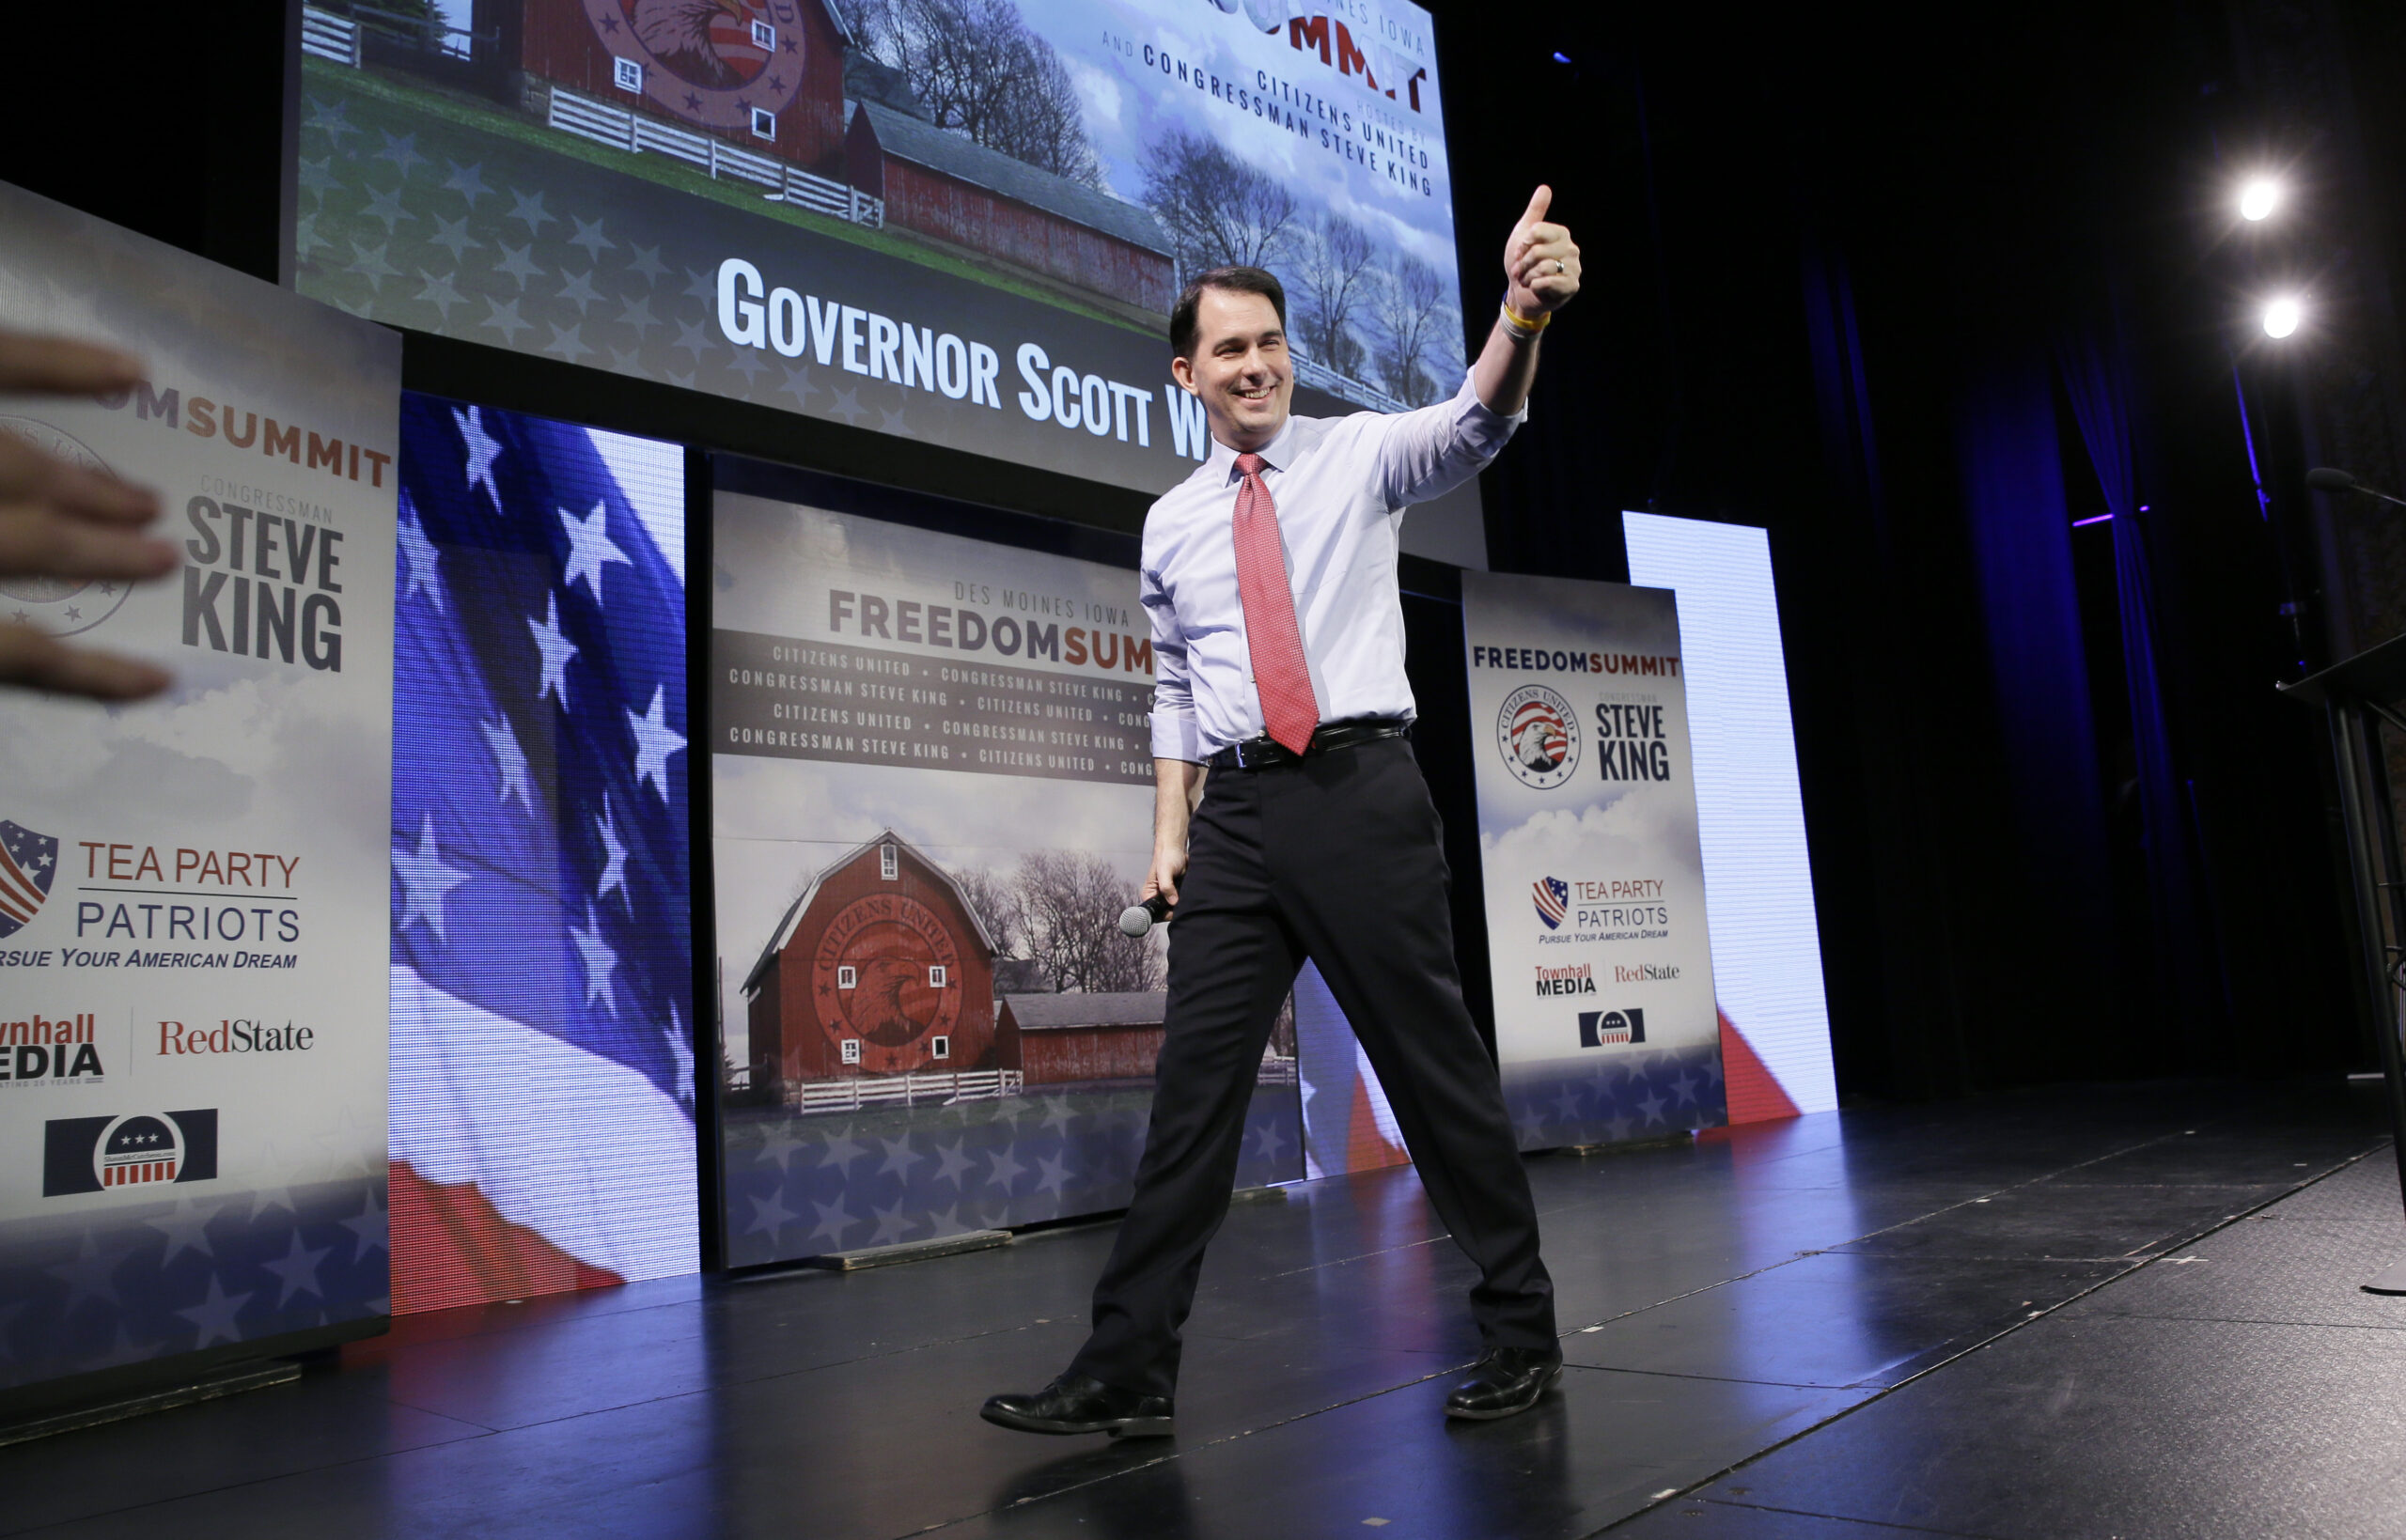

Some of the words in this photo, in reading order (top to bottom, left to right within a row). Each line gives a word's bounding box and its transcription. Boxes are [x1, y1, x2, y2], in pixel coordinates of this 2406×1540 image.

[1380, 14, 1425, 56] IOWA
[1102, 31, 1133, 57] AND
[1143, 44, 1308, 139] CONGRESSMAN
[1320, 128, 1378, 172] STEVE
[1387, 160, 1430, 196] KING
[1257, 70, 1351, 132] CITIZENS
[1362, 121, 1429, 169] UNITED
[201, 474, 334, 524] CONGRESSMAN
[185, 495, 344, 594] STEVE
[182, 565, 342, 673] KING
[955, 580, 991, 606] DES
[1003, 589, 1074, 619] MOINES
[1086, 602, 1129, 628] IOWA
[773, 646, 848, 669] CITIZENS
[856, 657, 910, 677] UNITED
[941, 667, 1043, 692] CONGRESSMAN
[1050, 680, 1087, 698] STEVE
[1093, 686, 1122, 703] KING
[1473, 646, 1680, 677] FREEDOMSUMMIT
[729, 668, 852, 696] CONGRESSMAN
[860, 684, 905, 702] STEVE
[912, 689, 947, 706] KING
[977, 696, 1040, 717] CITIZENS
[1046, 705, 1093, 722] UNITED
[1501, 689, 1539, 729] CITIZENS
[1542, 691, 1575, 730] UNITED
[773, 703, 849, 724] CITIZENS
[857, 711, 912, 730] UNITED
[943, 721, 1045, 743] CONGRESSMAN
[1051, 731, 1089, 748] STEVE
[1094, 736, 1124, 751] KING
[1595, 703, 1666, 739] STEVE
[729, 727, 853, 752] CONGRESSMAN
[862, 739, 906, 756] STEVE
[914, 743, 949, 759] KING
[979, 749, 1042, 768] CITIZENS
[1048, 755, 1095, 771] UNITED
[1598, 740, 1670, 782] KING
[79, 841, 164, 882] TEA
[175, 848, 301, 889] PARTY
[1575, 881, 1609, 900] TEA
[1612, 879, 1664, 898] PARTY
[76, 901, 301, 942] PATRIOTS
[819, 898, 892, 972] CITIZENS
[899, 901, 955, 968] UNITED
[1577, 907, 1668, 928] PATRIOTS
[1535, 963, 1591, 981] Townhall
[1536, 977, 1597, 996] MEDIA
[1615, 963, 1680, 983] RedState
[156, 1019, 314, 1055] RedState
